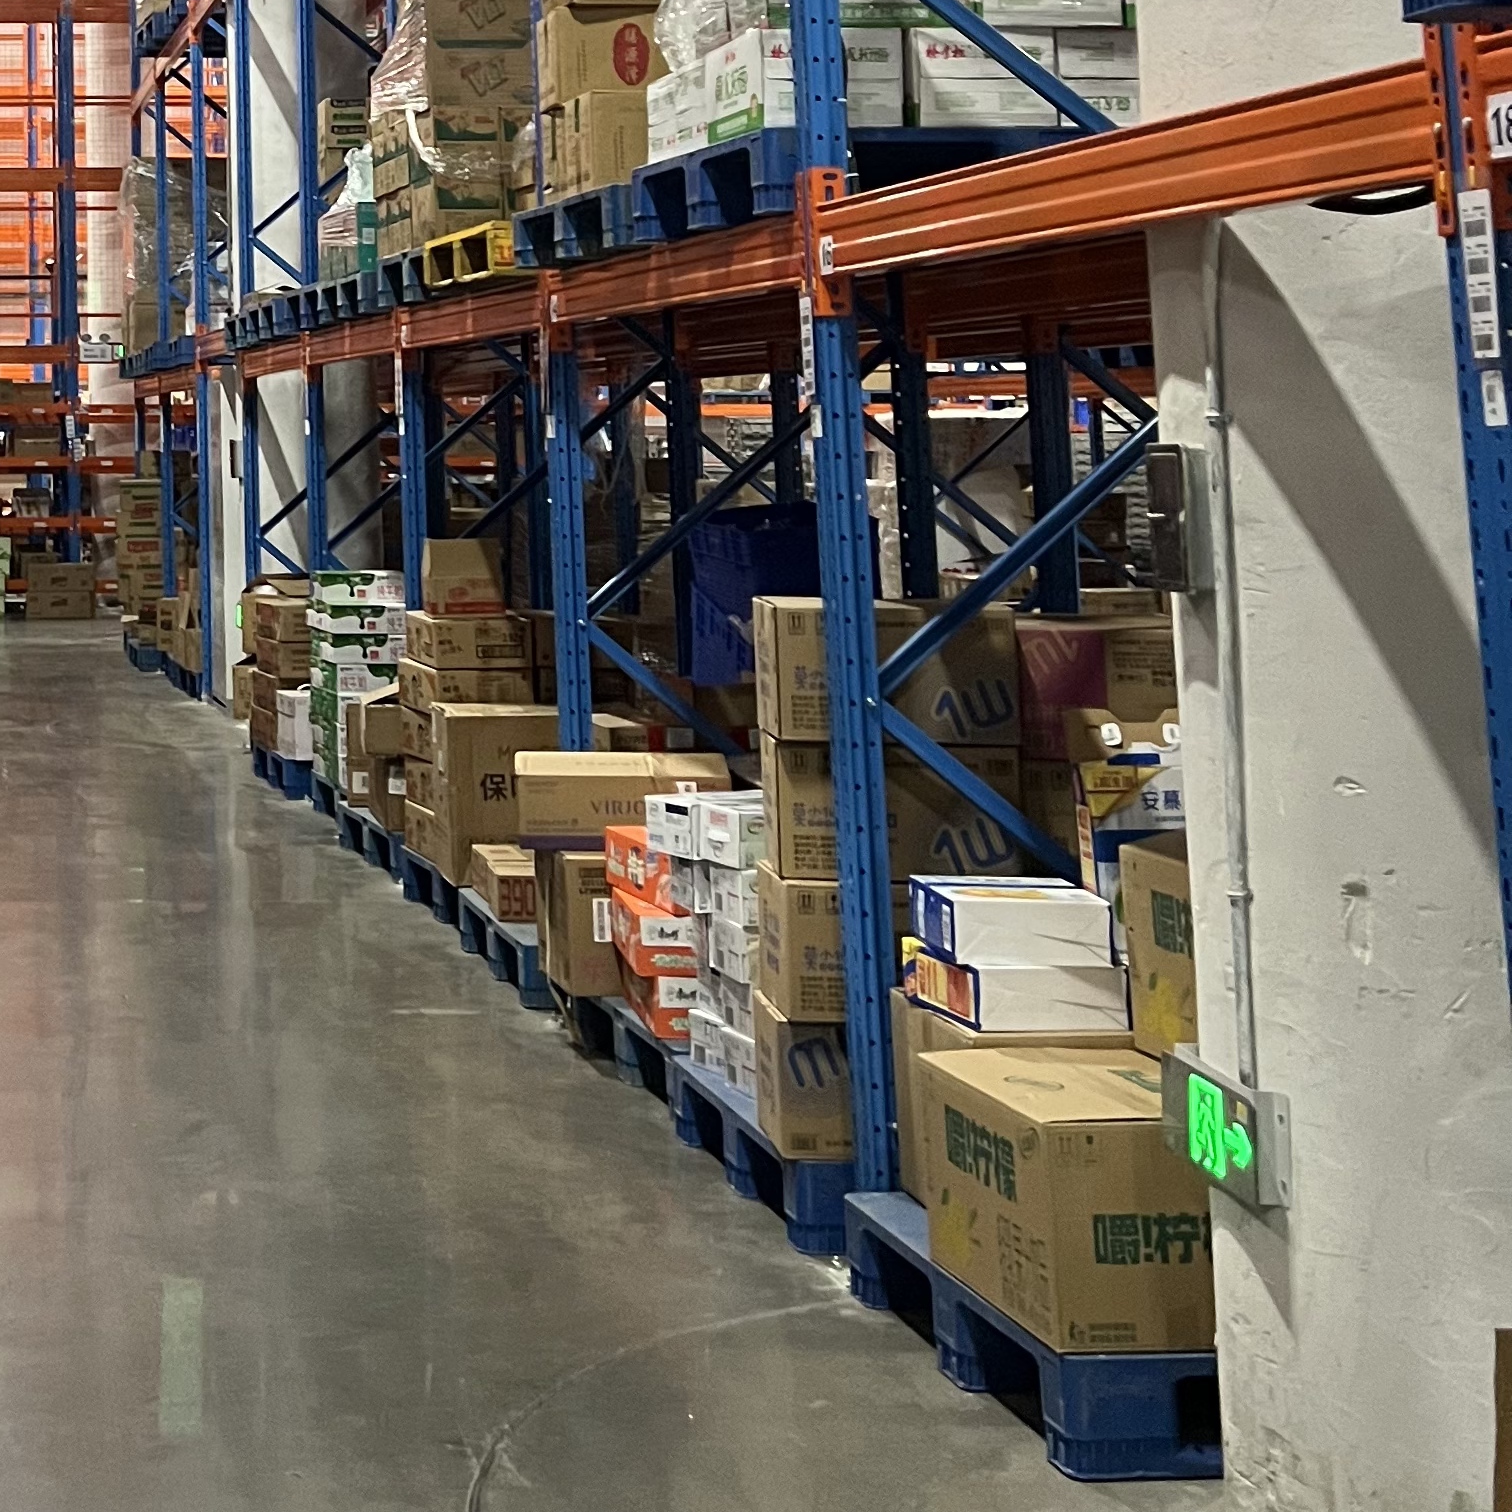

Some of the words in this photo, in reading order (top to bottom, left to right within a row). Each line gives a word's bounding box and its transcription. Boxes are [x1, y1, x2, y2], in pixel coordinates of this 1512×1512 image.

[480, 773, 517, 801] 保
[499, 878, 536, 917] 390
[1092, 1213, 1214, 1265] 嚼!柠
